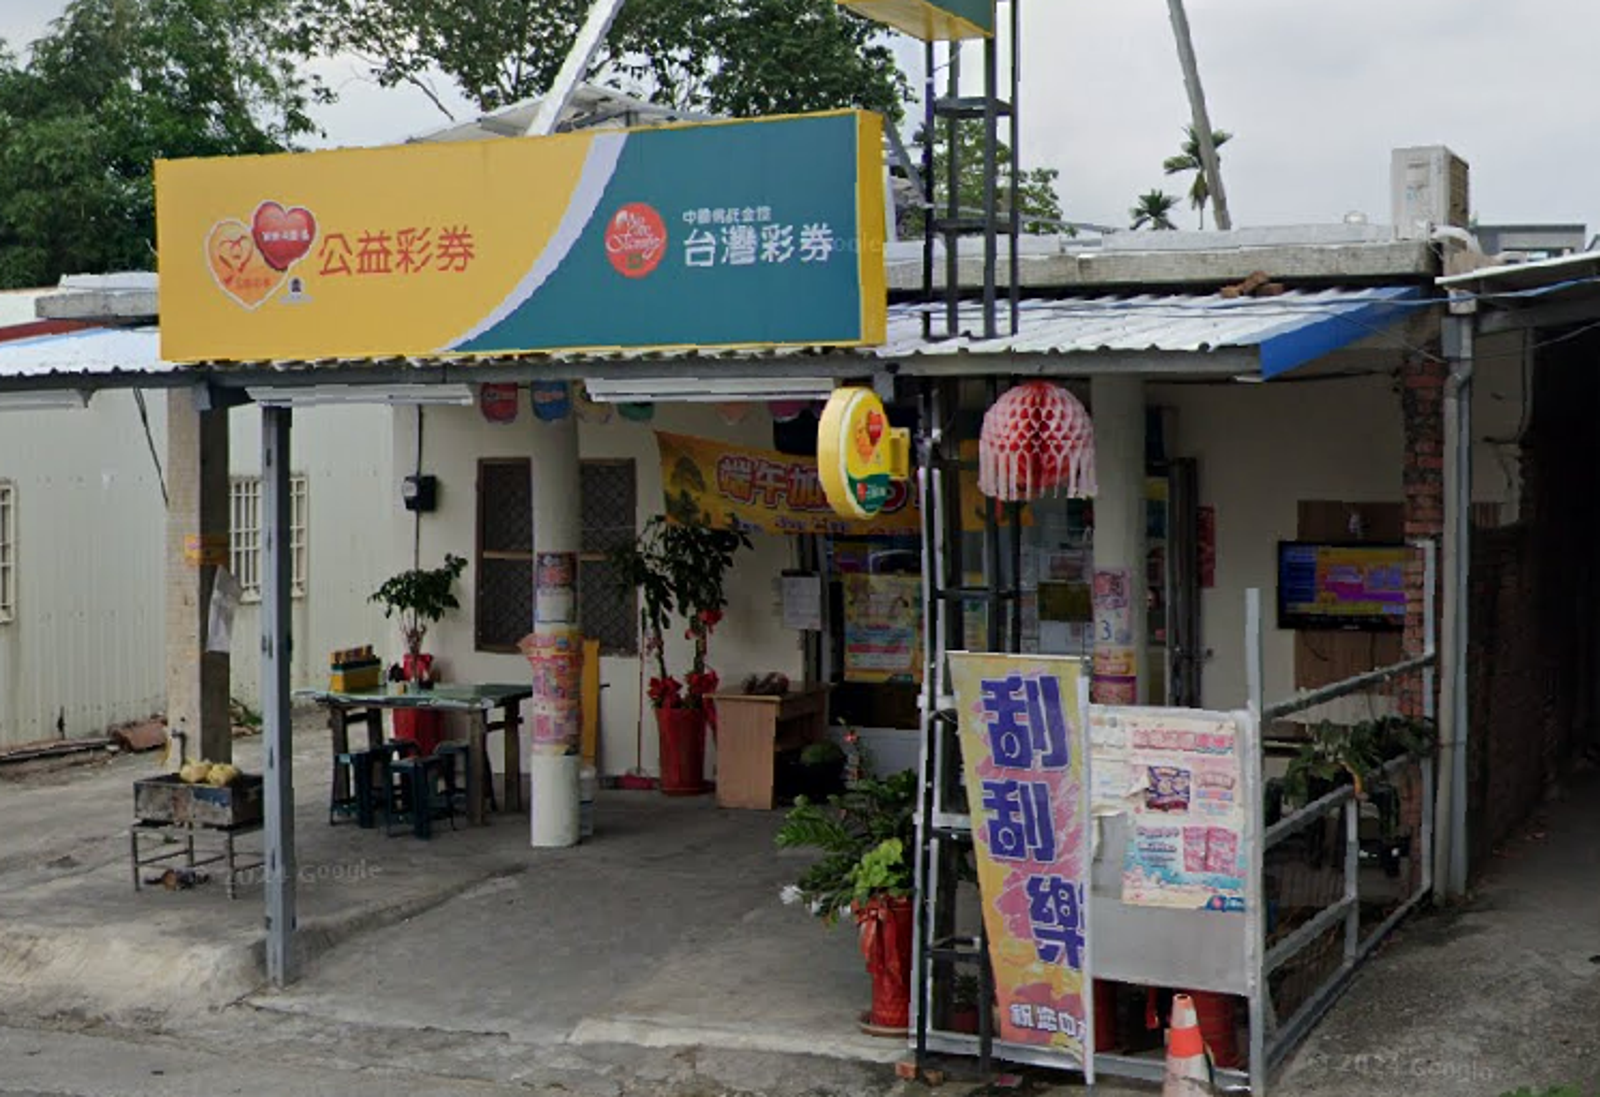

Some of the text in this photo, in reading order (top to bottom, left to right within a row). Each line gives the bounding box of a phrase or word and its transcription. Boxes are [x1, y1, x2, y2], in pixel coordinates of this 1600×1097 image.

[318, 224, 476, 276] 公益彩券
[682, 223, 833, 268] 台灣彩券
